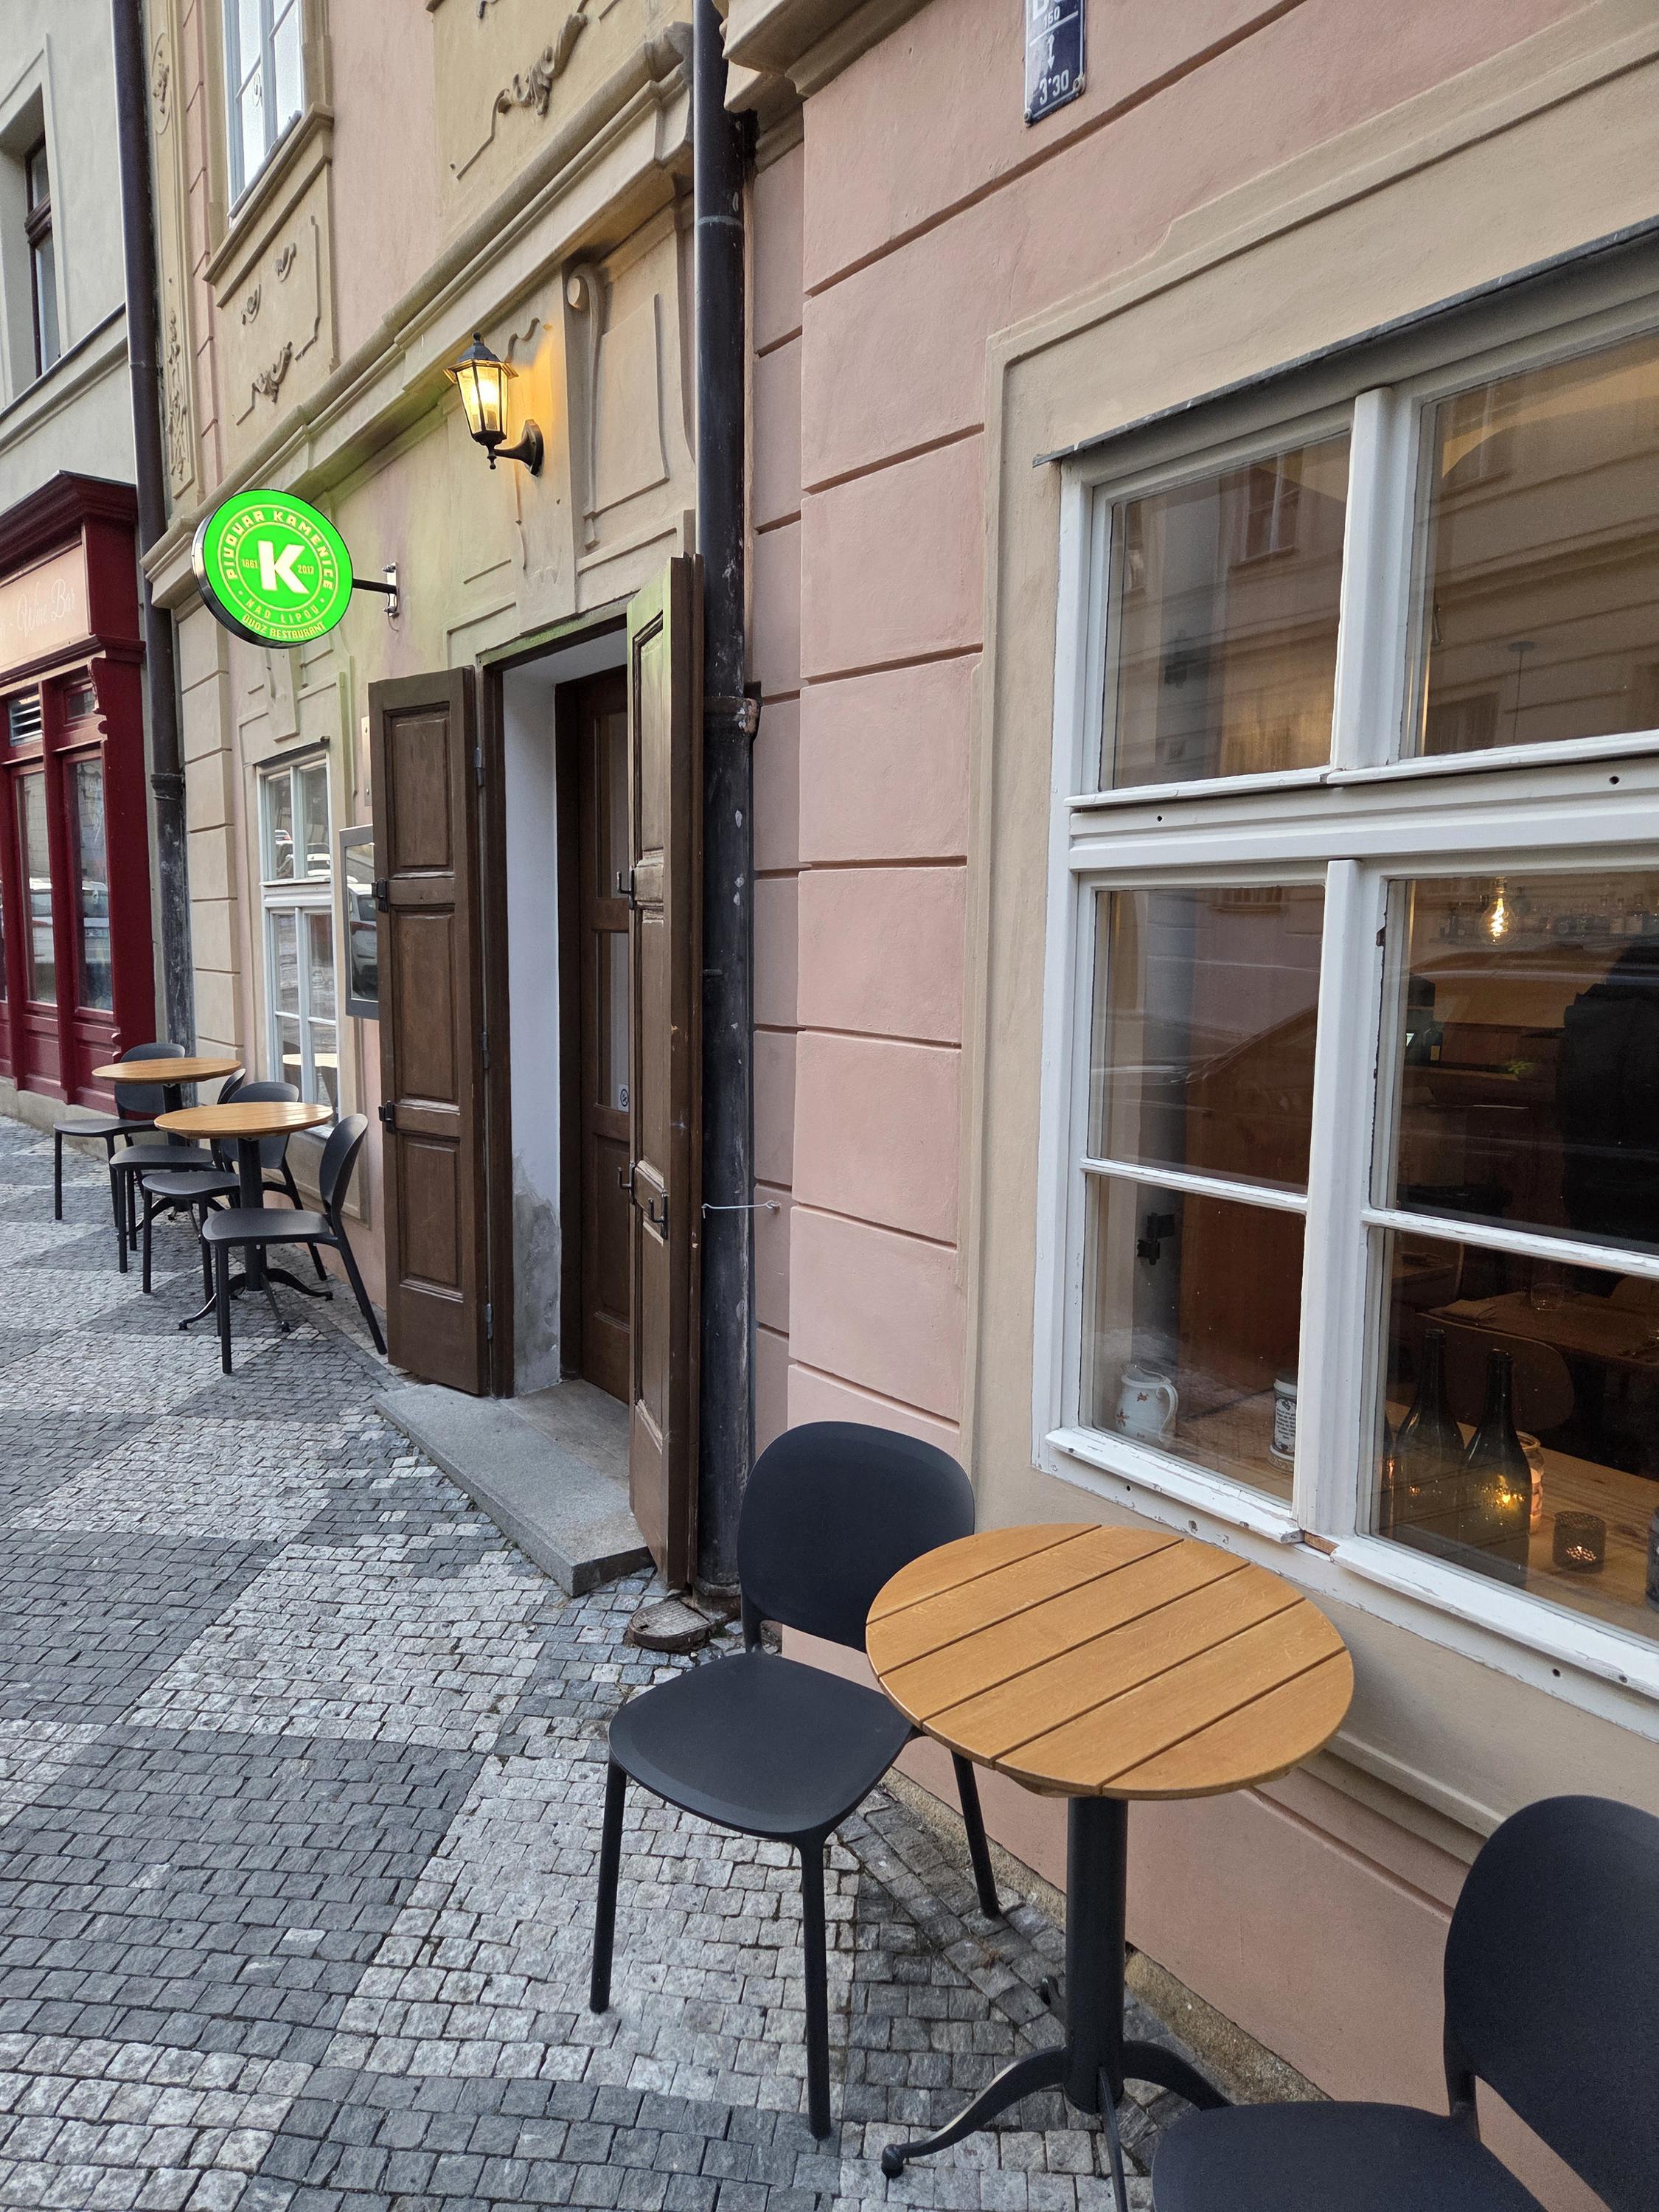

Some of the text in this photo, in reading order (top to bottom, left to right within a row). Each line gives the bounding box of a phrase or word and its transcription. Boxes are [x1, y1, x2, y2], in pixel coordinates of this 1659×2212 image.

[274, 510, 333, 590] KAMENICE
[242, 559, 258, 569] 1861
[258, 540, 310, 594] K
[297, 565, 315, 575] 2017
[17, 581, 48, 636] Wine
[51, 578, 76, 621] Bar
[246, 599, 319, 624] NAD LIPOU
[270, 622, 325, 639] RESTAURANT
